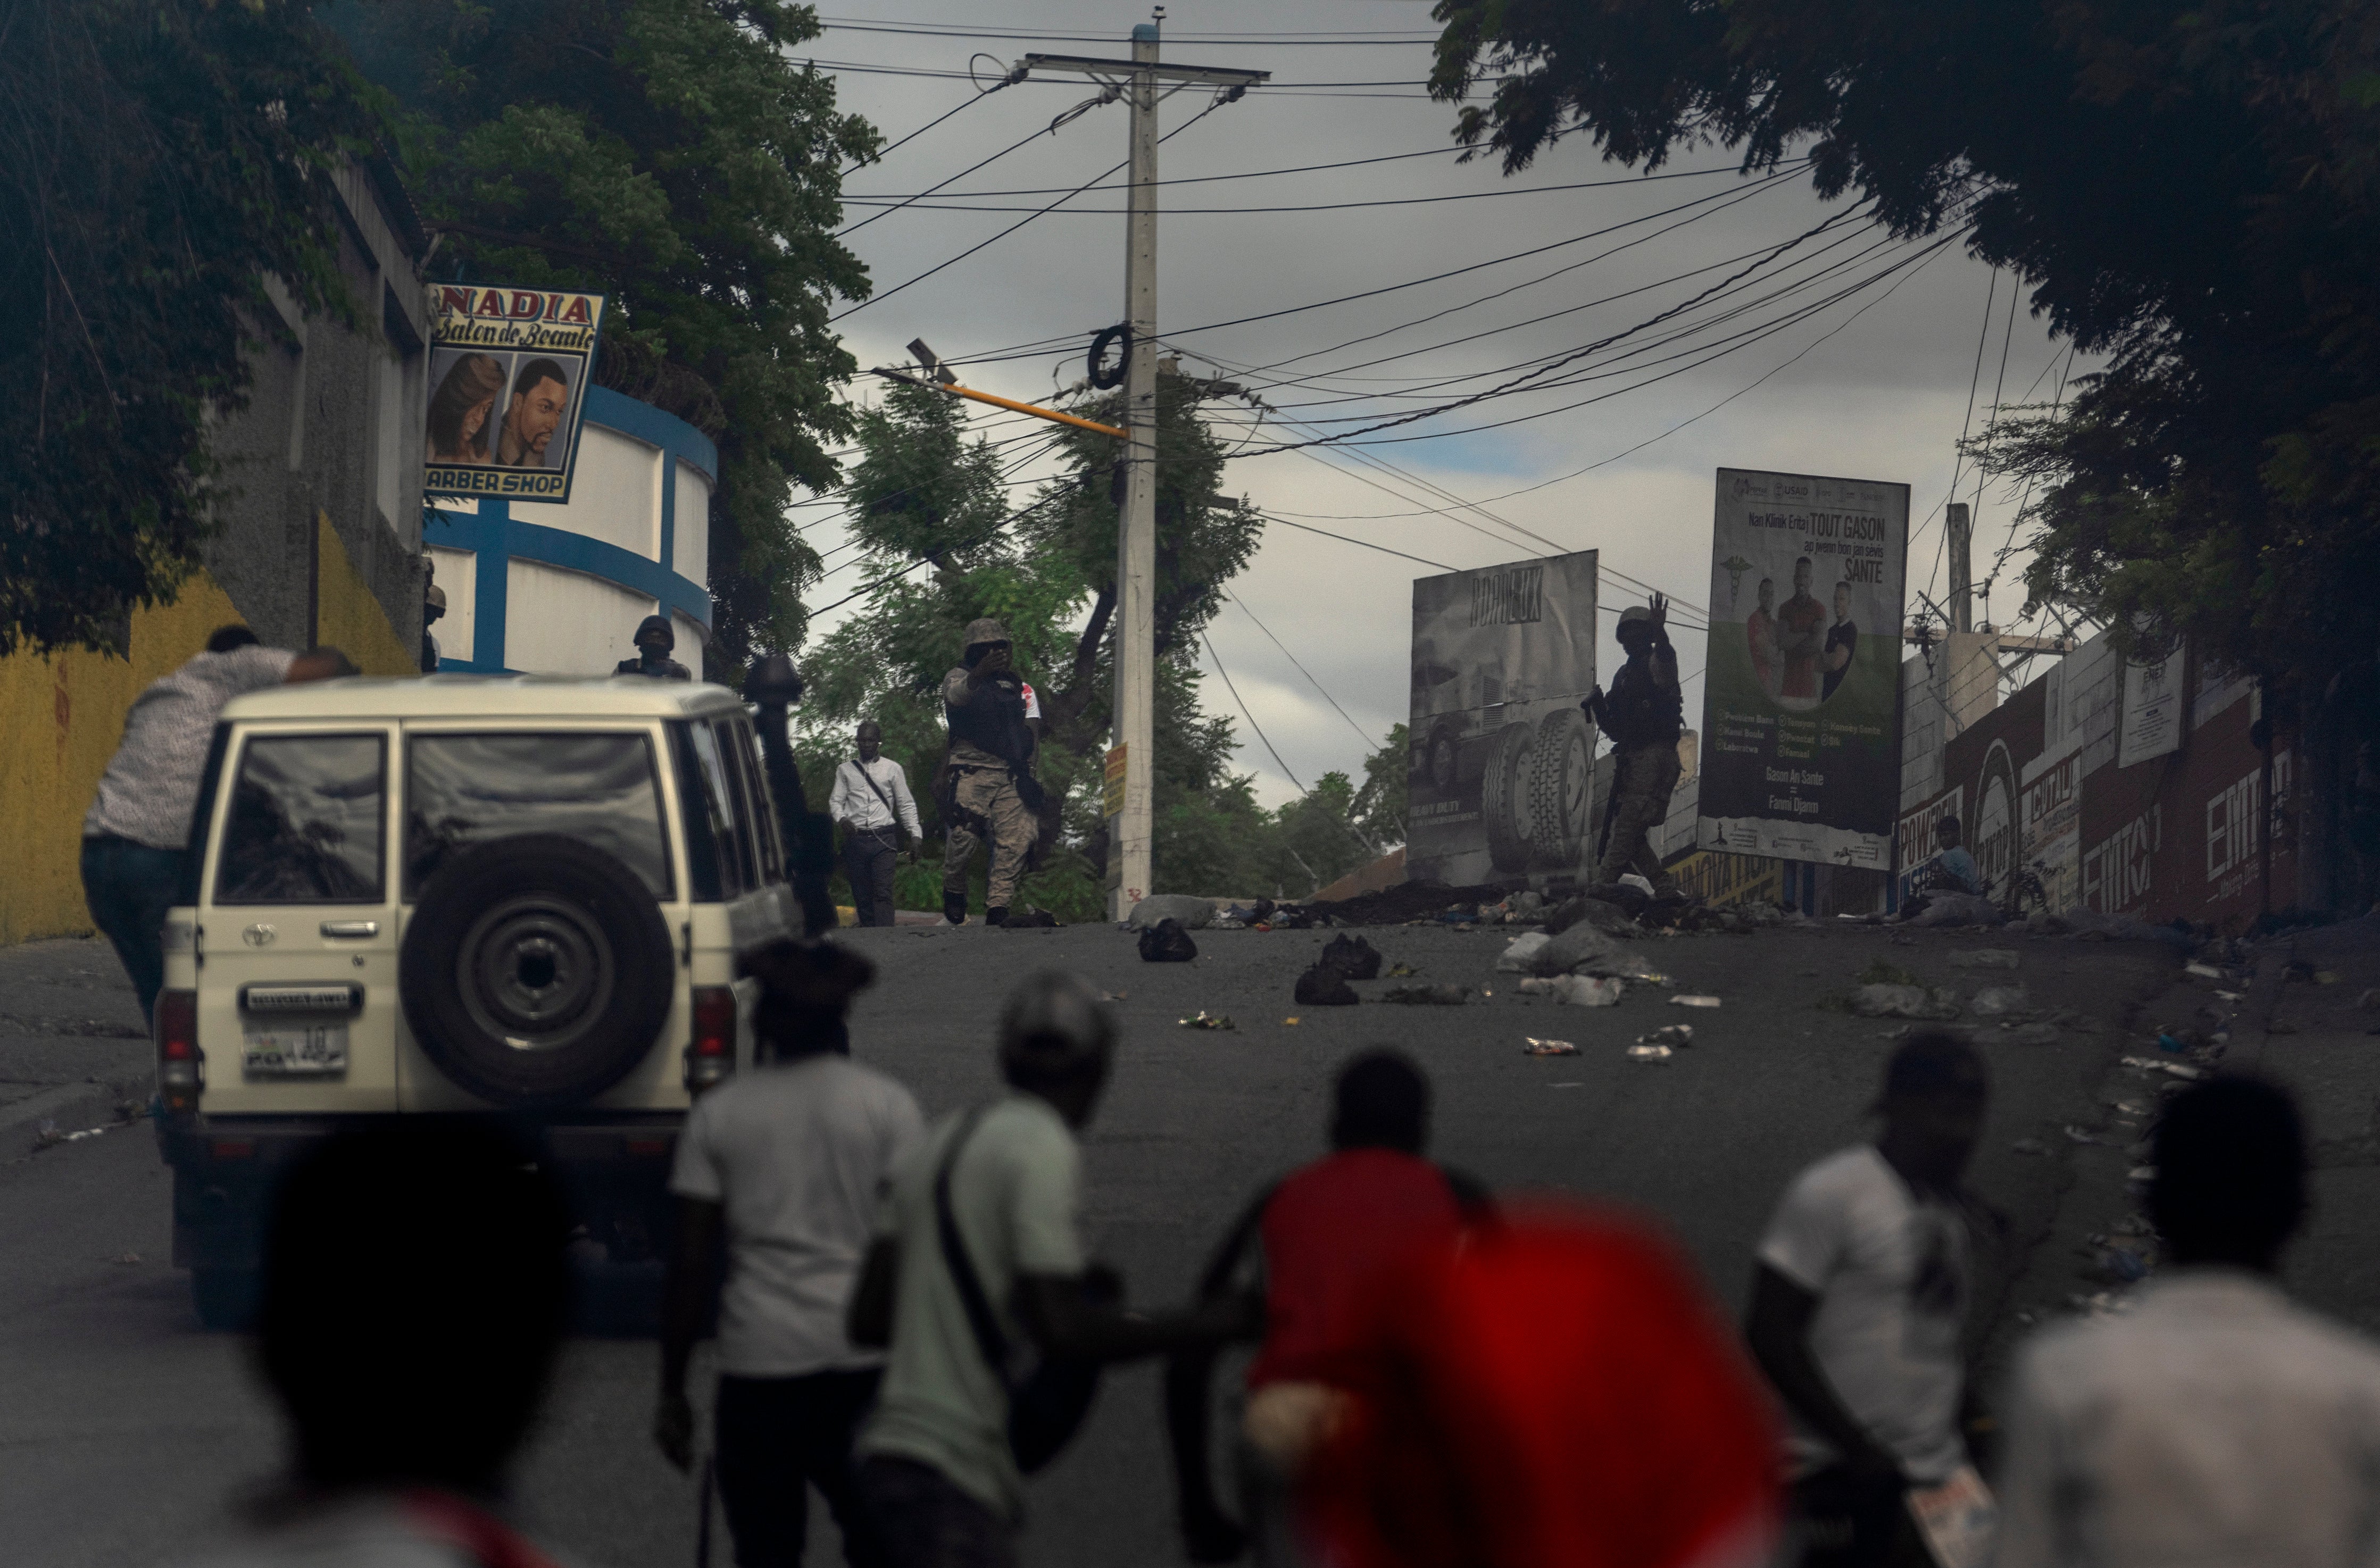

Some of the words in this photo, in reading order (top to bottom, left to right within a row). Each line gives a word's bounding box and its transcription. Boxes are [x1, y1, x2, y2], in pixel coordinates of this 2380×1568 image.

[440, 286, 593, 327] NADIA
[436, 319, 501, 343] Salon
[503, 321, 520, 344] de
[427, 470, 499, 491] ARBER
[502, 474, 563, 494] SHOP
[1785, 486, 1808, 496] USAID
[1749, 512, 1765, 527] Nan
[1765, 513, 1786, 529] Klinik
[1809, 512, 1842, 538] TOUT
[1844, 515, 1885, 541] GASON
[1837, 541, 1852, 554] bon
[1844, 558, 1883, 584] SANTE
[1766, 766, 1788, 782] Gason
[1790, 769, 1800, 784] An
[1801, 770, 1824, 786] Sante
[1769, 794, 1792, 811] Fanmi
